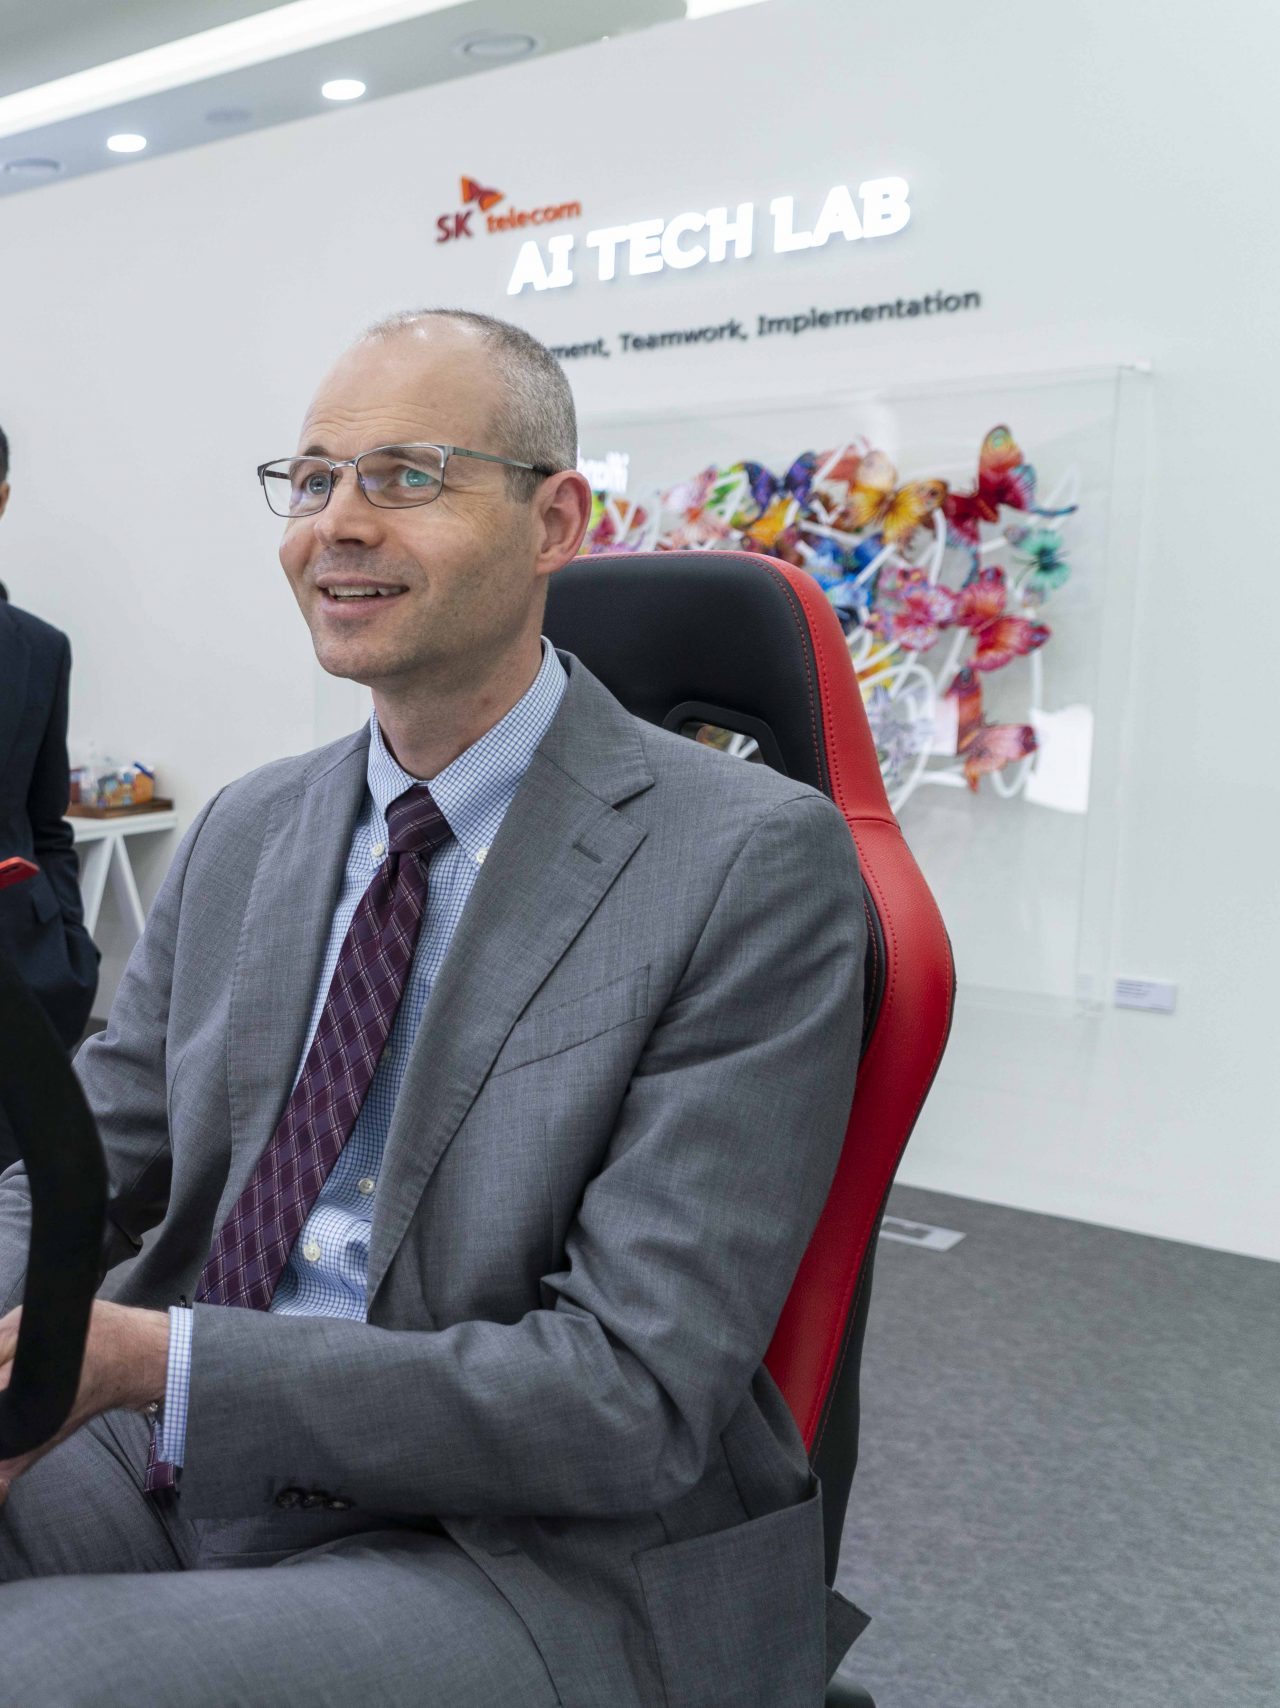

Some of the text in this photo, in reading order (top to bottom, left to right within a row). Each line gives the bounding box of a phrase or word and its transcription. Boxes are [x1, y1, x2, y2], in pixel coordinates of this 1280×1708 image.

[436, 200, 582, 243] SK telecom
[507, 177, 911, 295] AI TECH LAB
[619, 317, 748, 351] Teamwork,
[757, 288, 981, 340] Implementation
